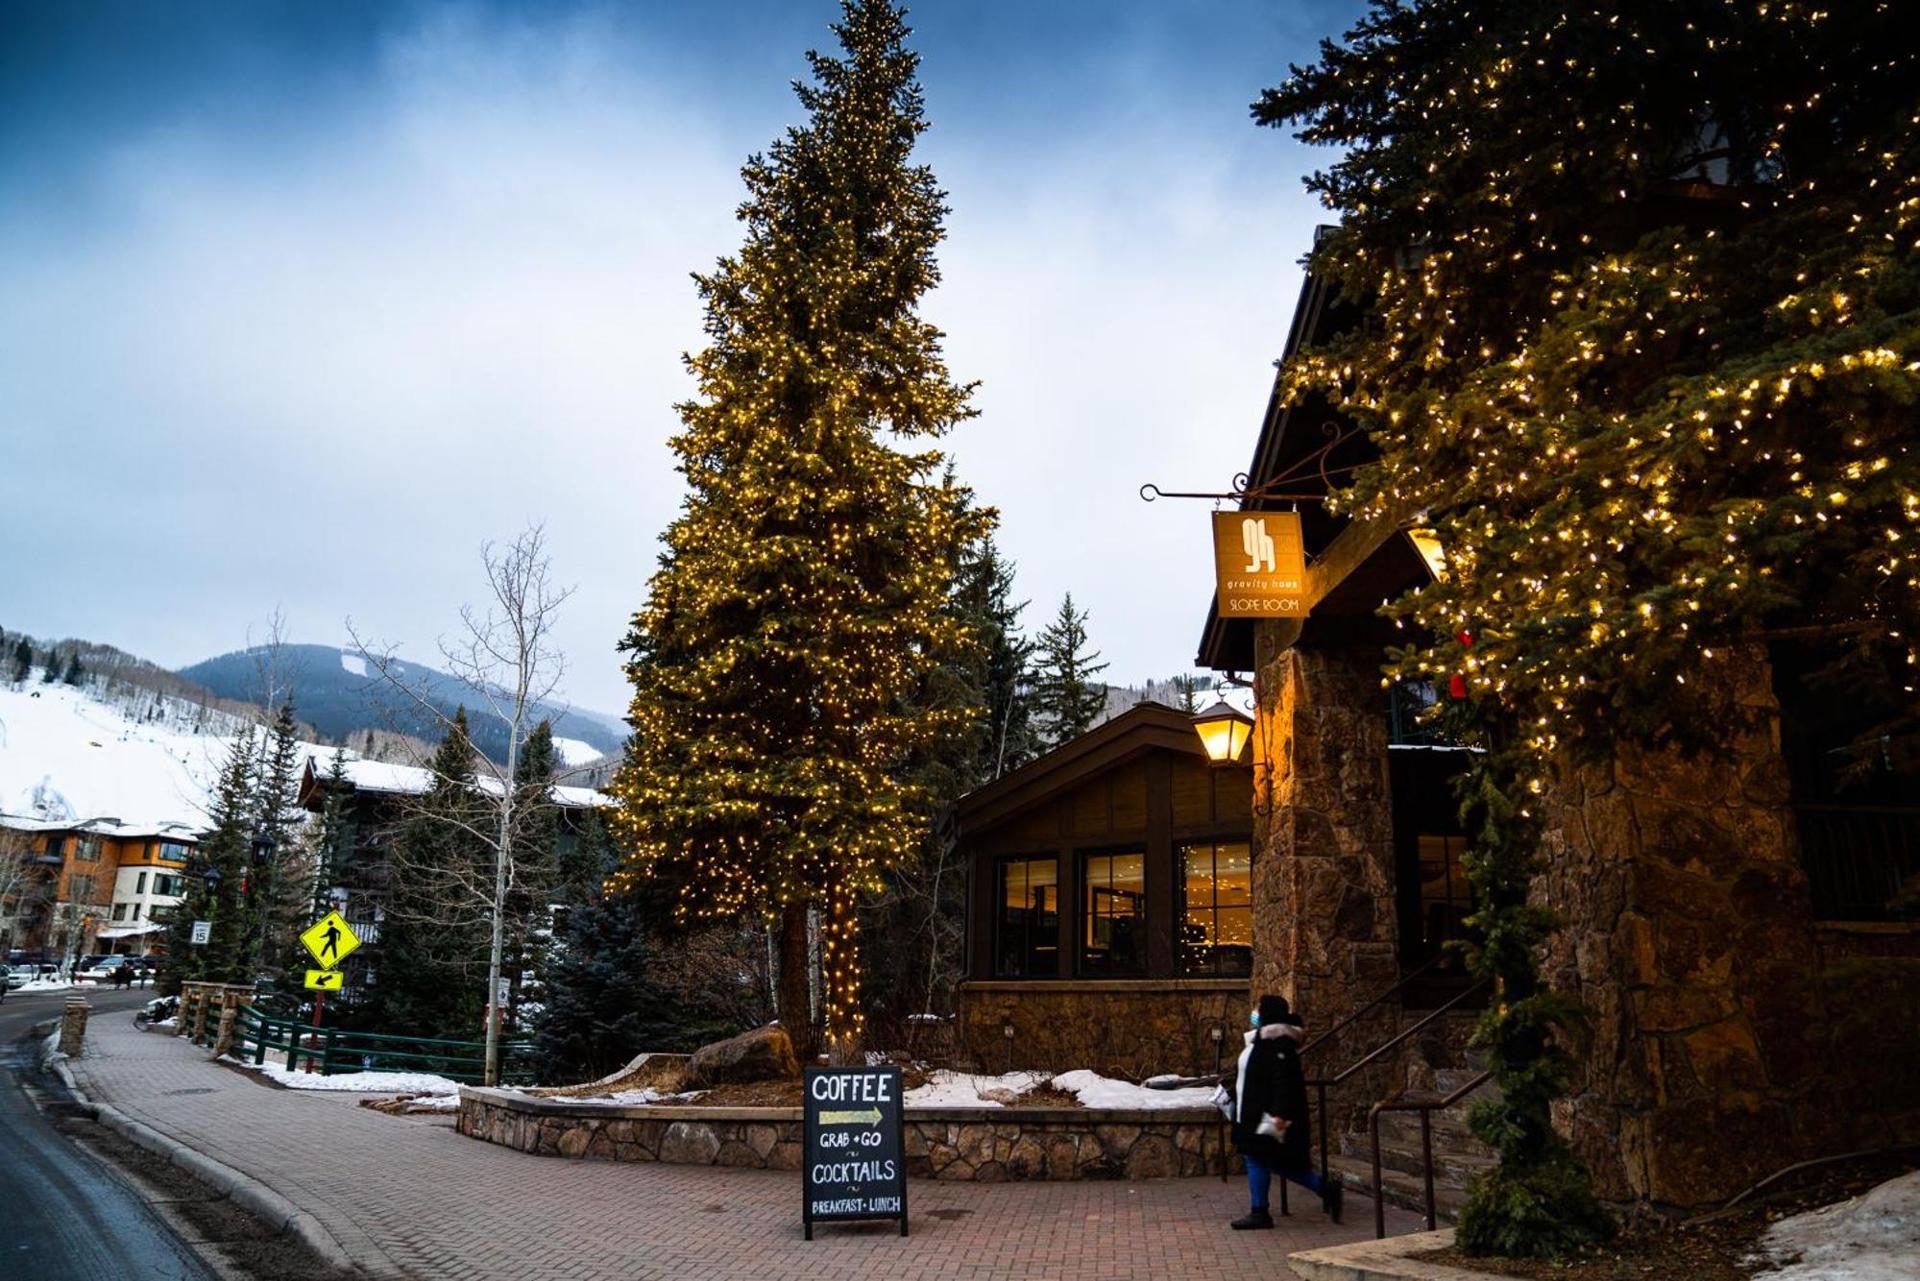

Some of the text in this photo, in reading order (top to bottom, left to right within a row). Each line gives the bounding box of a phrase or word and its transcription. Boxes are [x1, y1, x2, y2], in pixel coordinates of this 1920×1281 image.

[1227, 579, 1268, 590] gravity
[1230, 599, 1299, 611] SLOPE ROOM
[195, 932, 206, 941] 15
[812, 1074, 892, 1102] COFFEE
[820, 1132, 850, 1147] GRAB
[861, 1132, 882, 1146] GO
[812, 1160, 895, 1184] COCKTAILS
[869, 1196, 901, 1212] LUNCH
